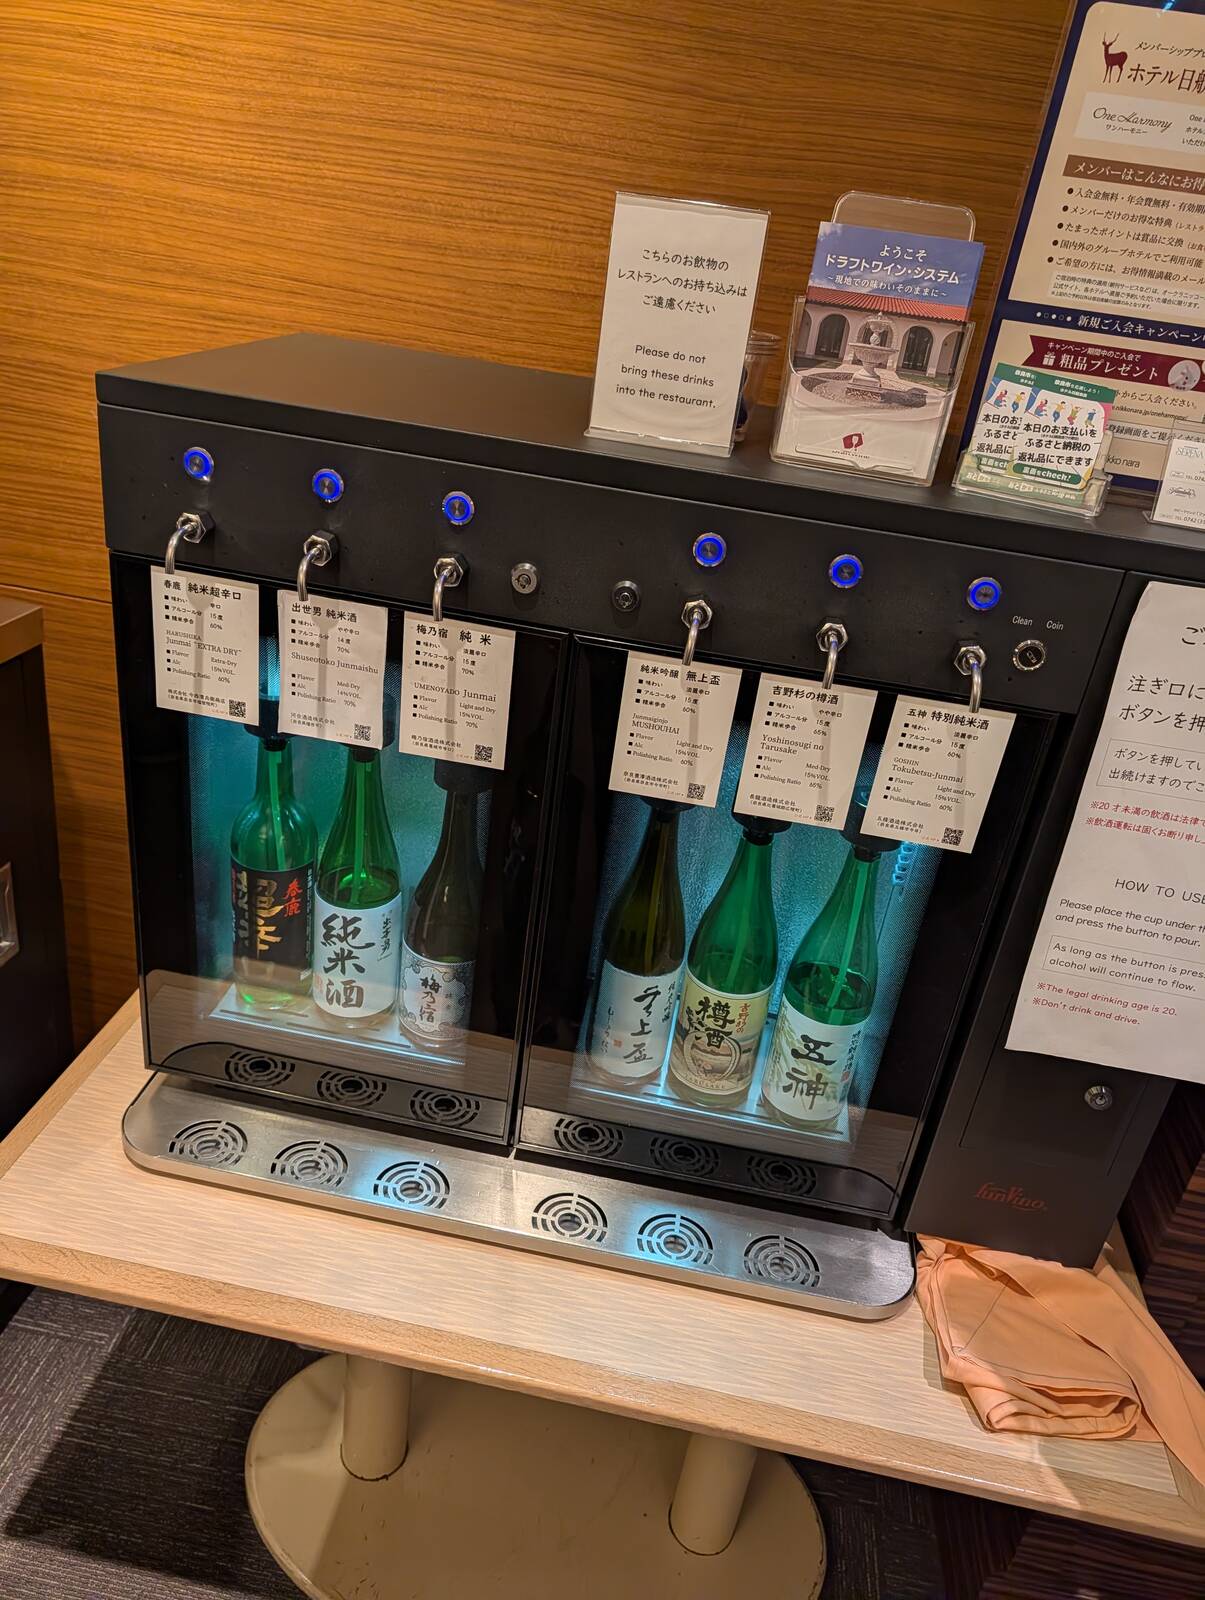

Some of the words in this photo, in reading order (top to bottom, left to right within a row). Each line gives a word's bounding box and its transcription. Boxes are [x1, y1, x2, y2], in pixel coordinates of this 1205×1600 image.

[1075, 188, 1205, 214] 入会金無料・年会費無料・有効期
[642, 249, 729, 271] こちらのお飲物の
[880, 245, 927, 262] ようこそ
[826, 254, 959, 284] ドラフトワイン・システム
[618, 269, 748, 296] レストランへのお持ち込みは
[642, 295, 716, 314] ご遠慮ください
[1078, 315, 1205, 342] 新規ご入会キャンペーン
[635, 345, 669, 359] Please
[673, 351, 685, 360] do
[689, 355, 706, 364] not
[621, 364, 647, 378] bring
[651, 368, 679, 381] these
[683, 374, 714, 386] drinks
[1060, 353, 1158, 380] 粗品プレゼント
[616, 385, 635, 395] into
[639, 387, 655, 399] the
[658, 392, 716, 408] restaurant.
[983, 414, 1022, 426] 本日のお
[1023, 423, 1097, 438] 本日のお支払いを
[984, 429, 1018, 441] ふるさと
[1025, 438, 1091, 452] ふるさと納税の
[1018, 452, 1093, 467] 返礼品にできます
[1123, 459, 1140, 468] nara
[164, 579, 181, 590] 春鹿
[188, 583, 241, 600] 純米超辛口
[292, 603, 322, 617] 出世男
[326, 608, 357, 623] 純米酒
[1012, 616, 1033, 626] Clean
[1046, 620, 1064, 630] Coin
[417, 624, 448, 638] 梅乃宿
[1182, 627, 1205, 645] ご
[166, 637, 191, 648] Junmai
[291, 651, 335, 666] Shuseotoko
[336, 659, 378, 674] Junmaishu
[640, 664, 679, 678] 純米吟醸
[686, 671, 721, 686] 無上盃
[414, 682, 460, 696] UMENOYADO
[462, 689, 497, 702] Junmai
[773, 686, 839, 705] 吉野杉の樽酒
[1128, 675, 1204, 699] 注ぎ口に
[632, 721, 680, 735] MUSHOUHAI
[907, 709, 927, 719] 五神
[931, 711, 990, 731] 特別純米酒
[761, 742, 798, 755] Tarusake
[763, 734, 811, 750] Yoshinosugi
[892, 764, 964, 783] Tokubetsu-Junmai
[1086, 817, 1205, 844] ※飲酒運転は固くお断り申し
[1115, 878, 1149, 893] HOW
[1156, 886, 1175, 898] TO
[1059, 899, 1092, 912] Please
[1094, 906, 1123, 917] place
[1125, 911, 1141, 921] the
[1144, 916, 1163, 925] cup
[1165, 919, 1196, 931] under
[1055, 913, 1074, 923] and
[1076, 917, 1104, 928] press
[1107, 922, 1123, 932] the
[1126, 926, 1159, 939] button
[1162, 933, 1172, 941] to
[1174, 936, 1201, 947] pour.
[321, 913, 376, 1009] 純米酒
[1053, 943, 1067, 952] As
[1070, 946, 1092, 959] long
[1095, 952, 1107, 960] as
[1111, 954, 1127, 963] the
[1131, 957, 1165, 971] button
[1169, 964, 1177, 973] is
[1049, 957, 1086, 971] alcohol
[1089, 965, 1107, 974] will
[1109, 970, 1153, 984] continue
[1157, 977, 1168, 986] to
[1171, 979, 1196, 992] flow.
[1066, 988, 1089, 998] legal
[1091, 993, 1129, 1008] drinking
[1131, 1002, 1149, 1011] age
[1152, 1004, 1159, 1012] is
[1162, 1006, 1177, 1016] 20.
[1069, 1004, 1092, 1015] drink
[1094, 1010, 1112, 1019] and
[1114, 1015, 1140, 1025] drive.
[782, 1035, 837, 1110] 五神
